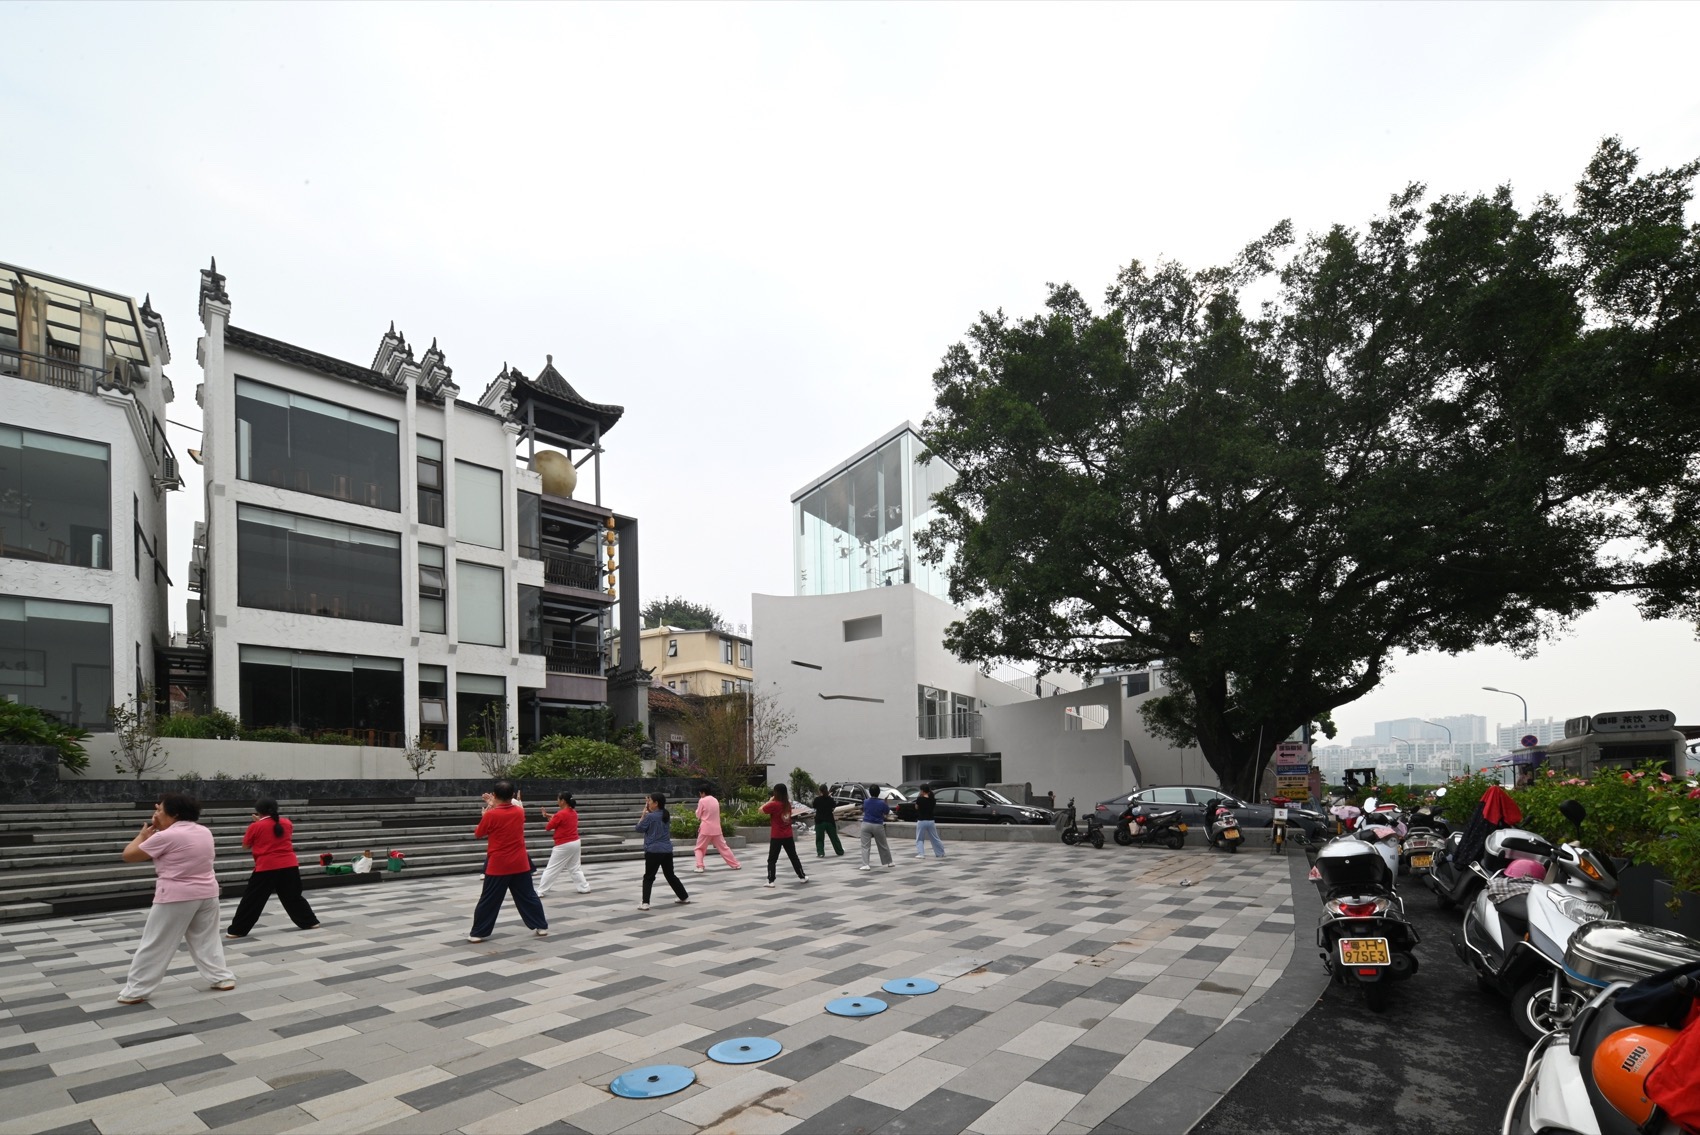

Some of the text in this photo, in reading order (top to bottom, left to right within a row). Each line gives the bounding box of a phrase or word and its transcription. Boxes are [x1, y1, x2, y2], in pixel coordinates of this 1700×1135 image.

[1597, 713, 1670, 725] 咖啡 茶饮 文创
[1345, 950, 1385, 962] 975E3
[1621, 1046, 1647, 1072] JUHU
